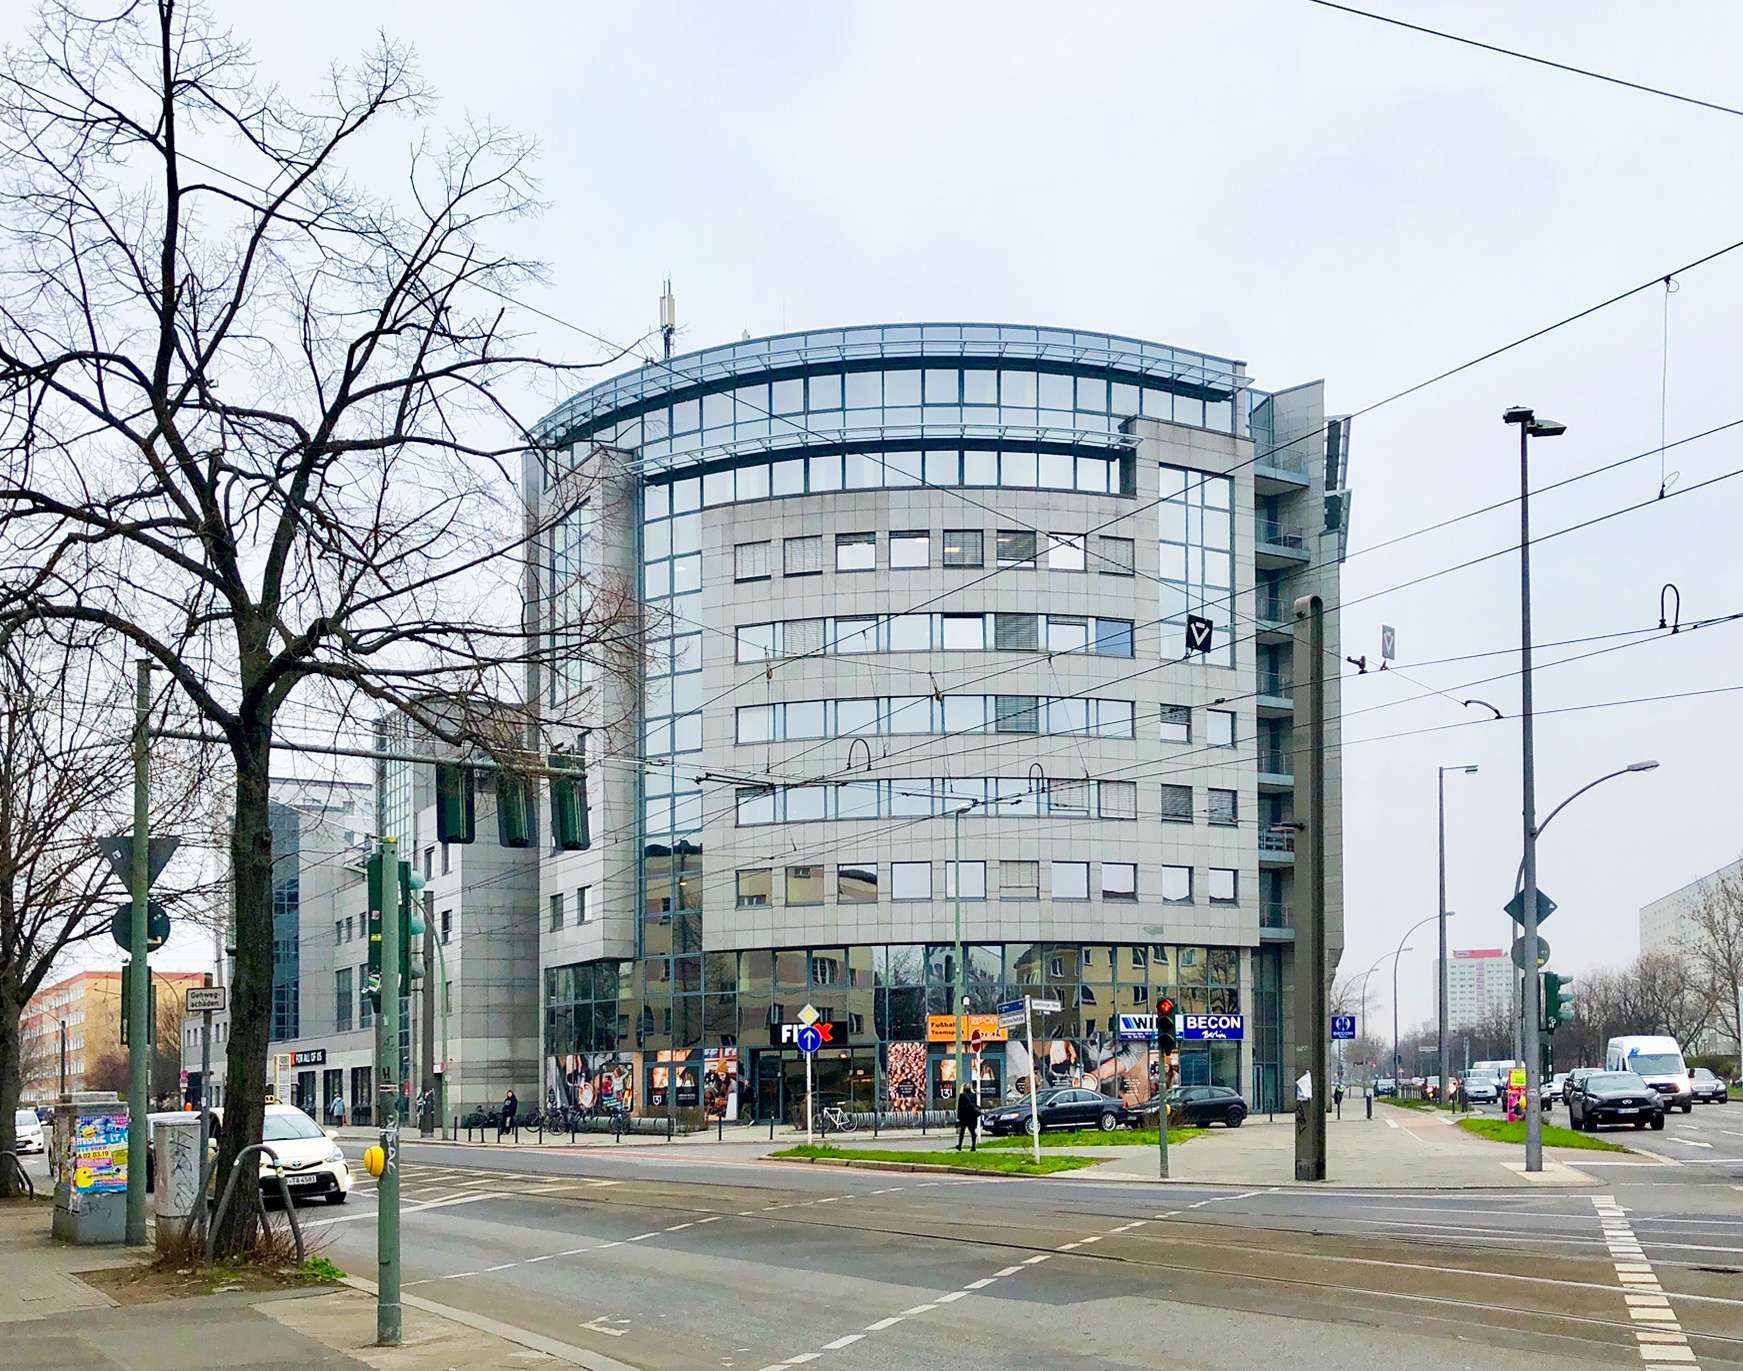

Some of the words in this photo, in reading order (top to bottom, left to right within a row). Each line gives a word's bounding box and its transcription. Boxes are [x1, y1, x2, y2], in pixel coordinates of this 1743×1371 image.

[190, 991, 221, 1000] Gehweg-
[1186, 1016, 1241, 1030] BECON
[781, 1022, 833, 1044] FIX
[1201, 1030, 1227, 1039] Berlin
